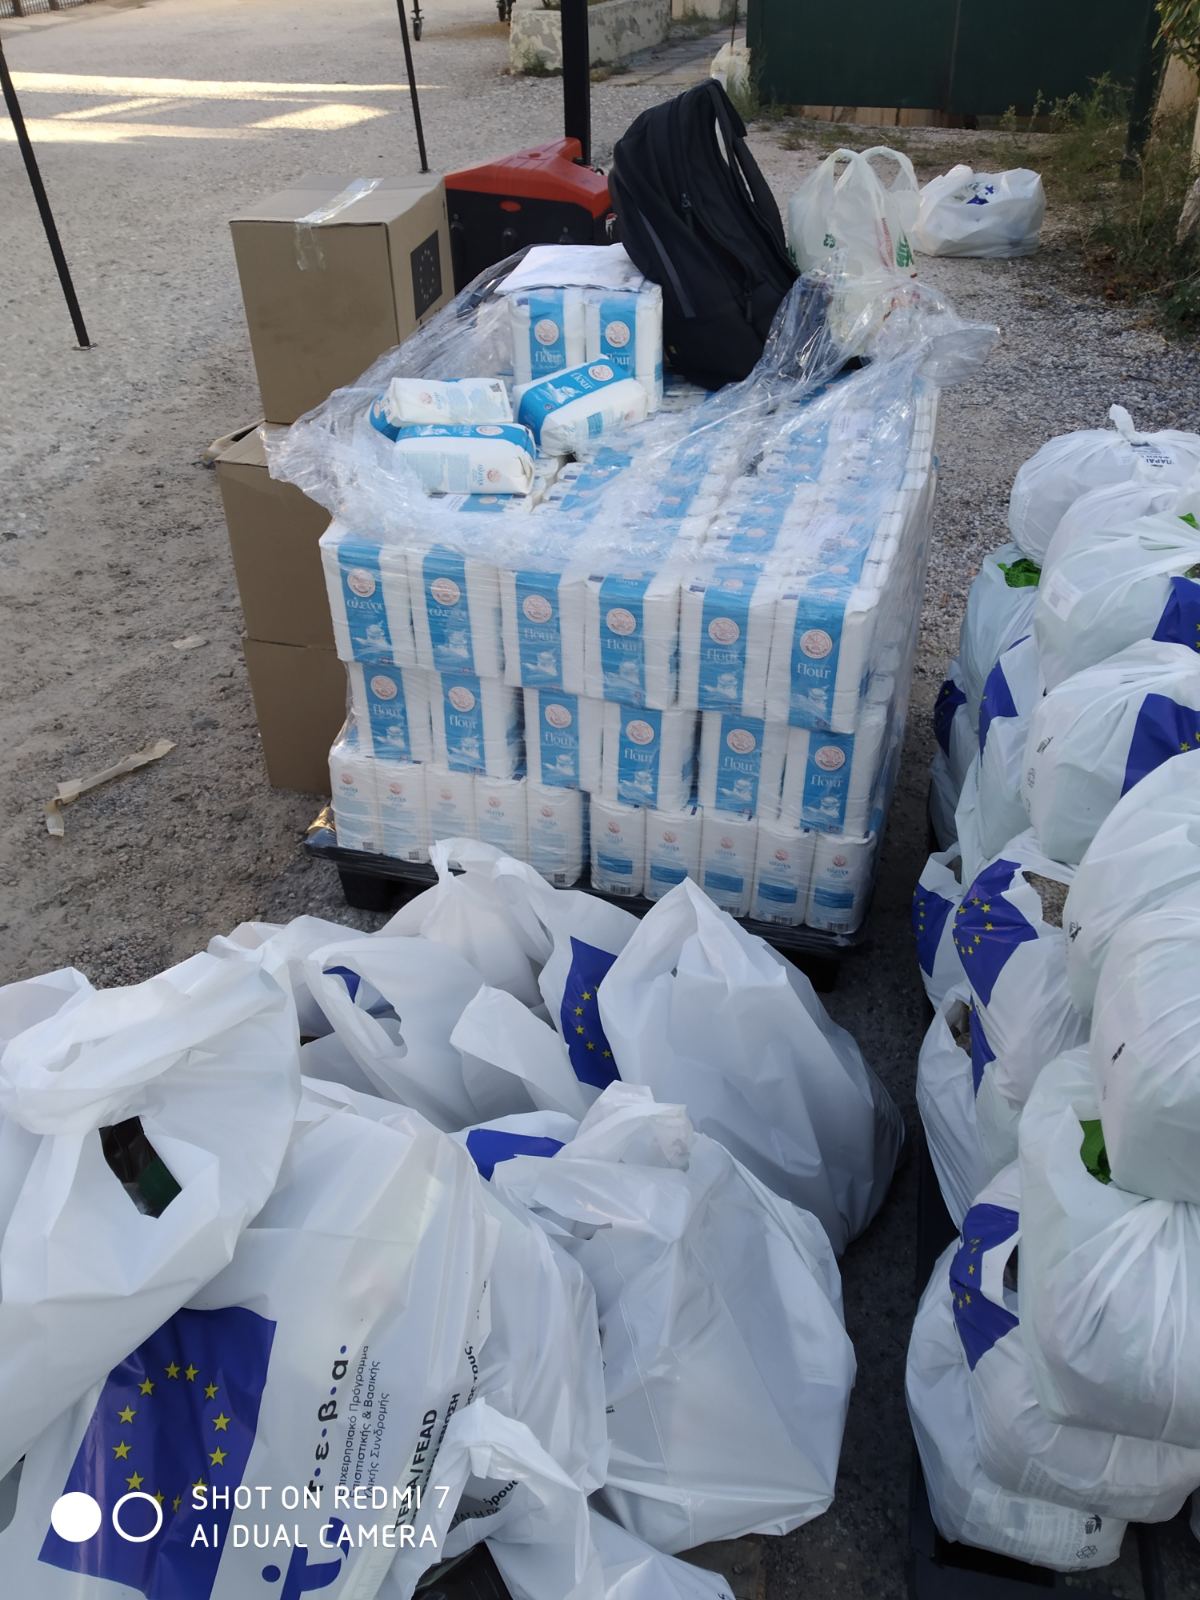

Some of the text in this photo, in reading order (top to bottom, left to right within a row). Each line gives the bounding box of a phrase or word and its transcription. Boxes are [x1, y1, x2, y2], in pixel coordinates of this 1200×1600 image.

[609, 352, 630, 365] lour
[796, 663, 832, 680] flour
[449, 715, 477, 729] flour
[624, 747, 653, 762] flour
[724, 757, 754, 771] flour
[811, 774, 844, 787] flour
[349, 1345, 369, 1412] Πρόγραμμα
[363, 1360, 381, 1408] Βασικής
[361, 1410, 372, 1420] &
[370, 1392, 390, 1459] Συνδρομής
